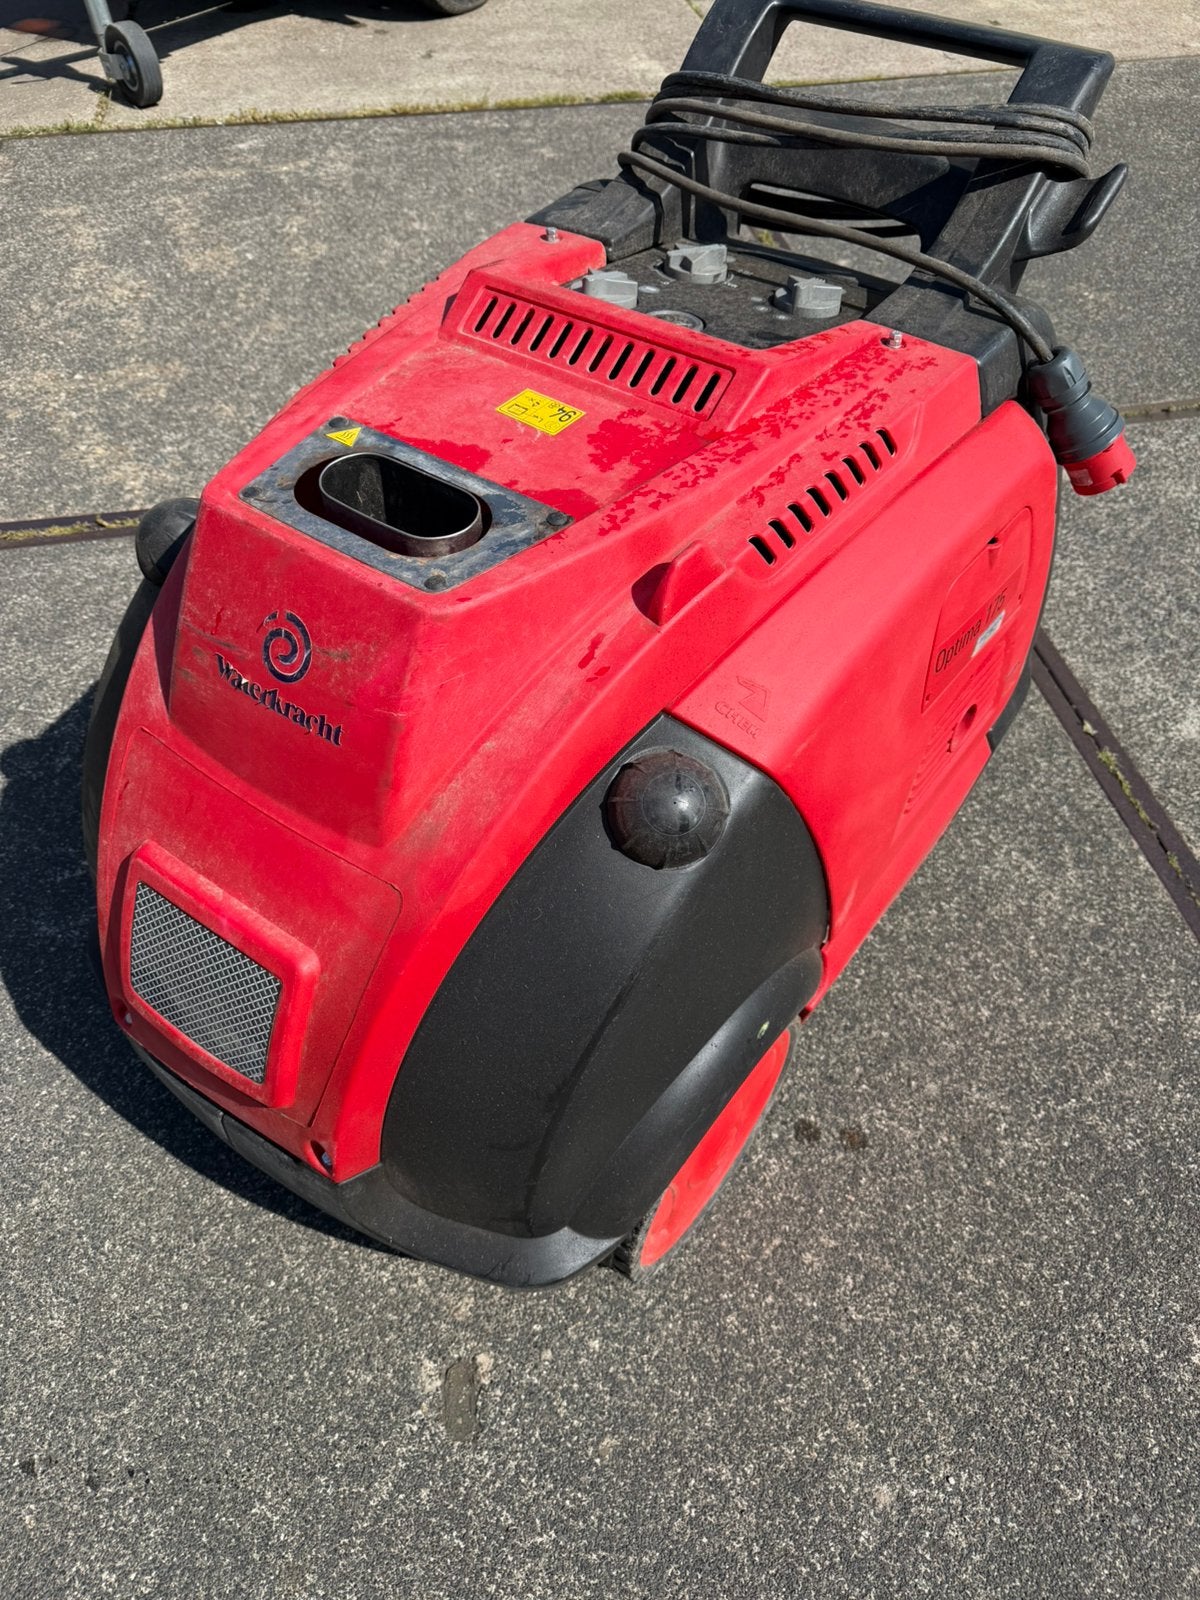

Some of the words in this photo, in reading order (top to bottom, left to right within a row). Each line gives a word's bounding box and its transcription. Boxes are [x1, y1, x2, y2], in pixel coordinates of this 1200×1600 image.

[548, 406, 577, 422] 94
[935, 618, 982, 673] Optima
[986, 587, 1008, 623] 175
[214, 652, 343, 747] Waterkracht
